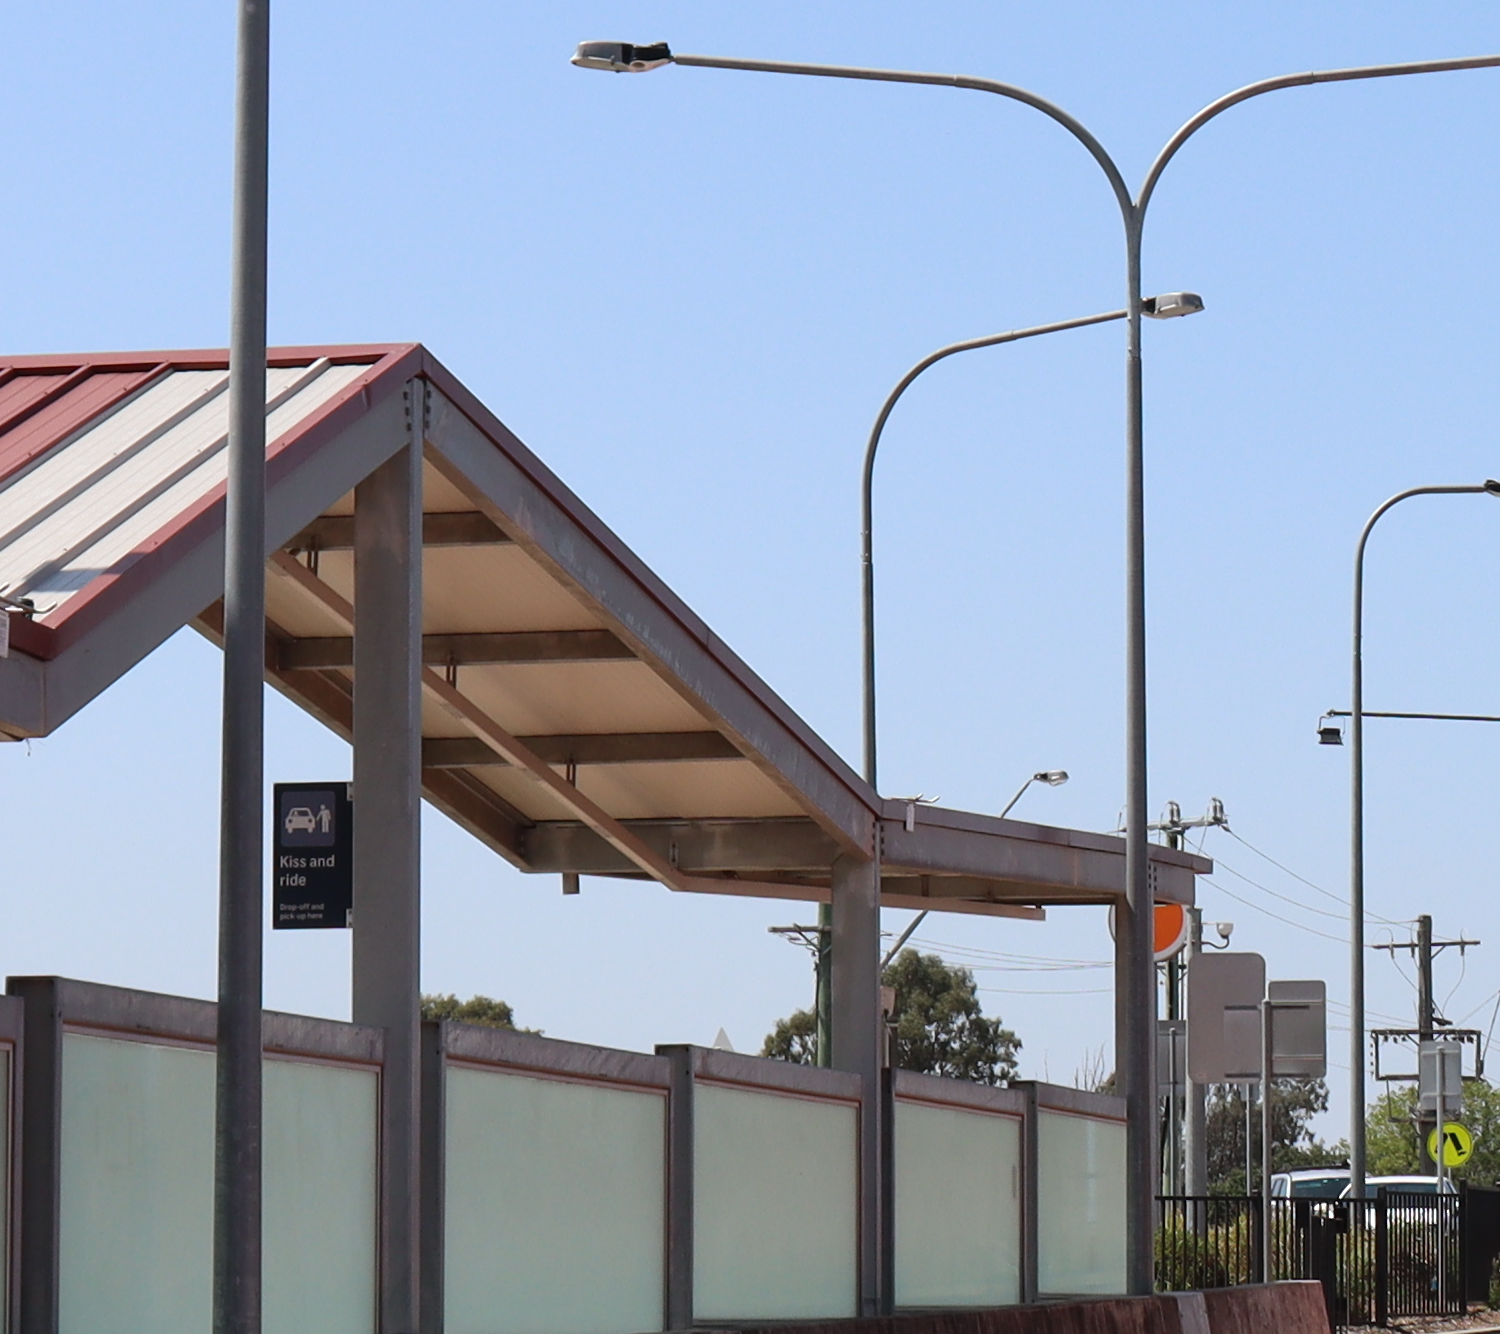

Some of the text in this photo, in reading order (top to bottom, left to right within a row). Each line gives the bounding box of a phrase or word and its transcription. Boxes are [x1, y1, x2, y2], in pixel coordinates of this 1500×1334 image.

[280, 854, 335, 868] Kiss and
[280, 873, 307, 886] ride
